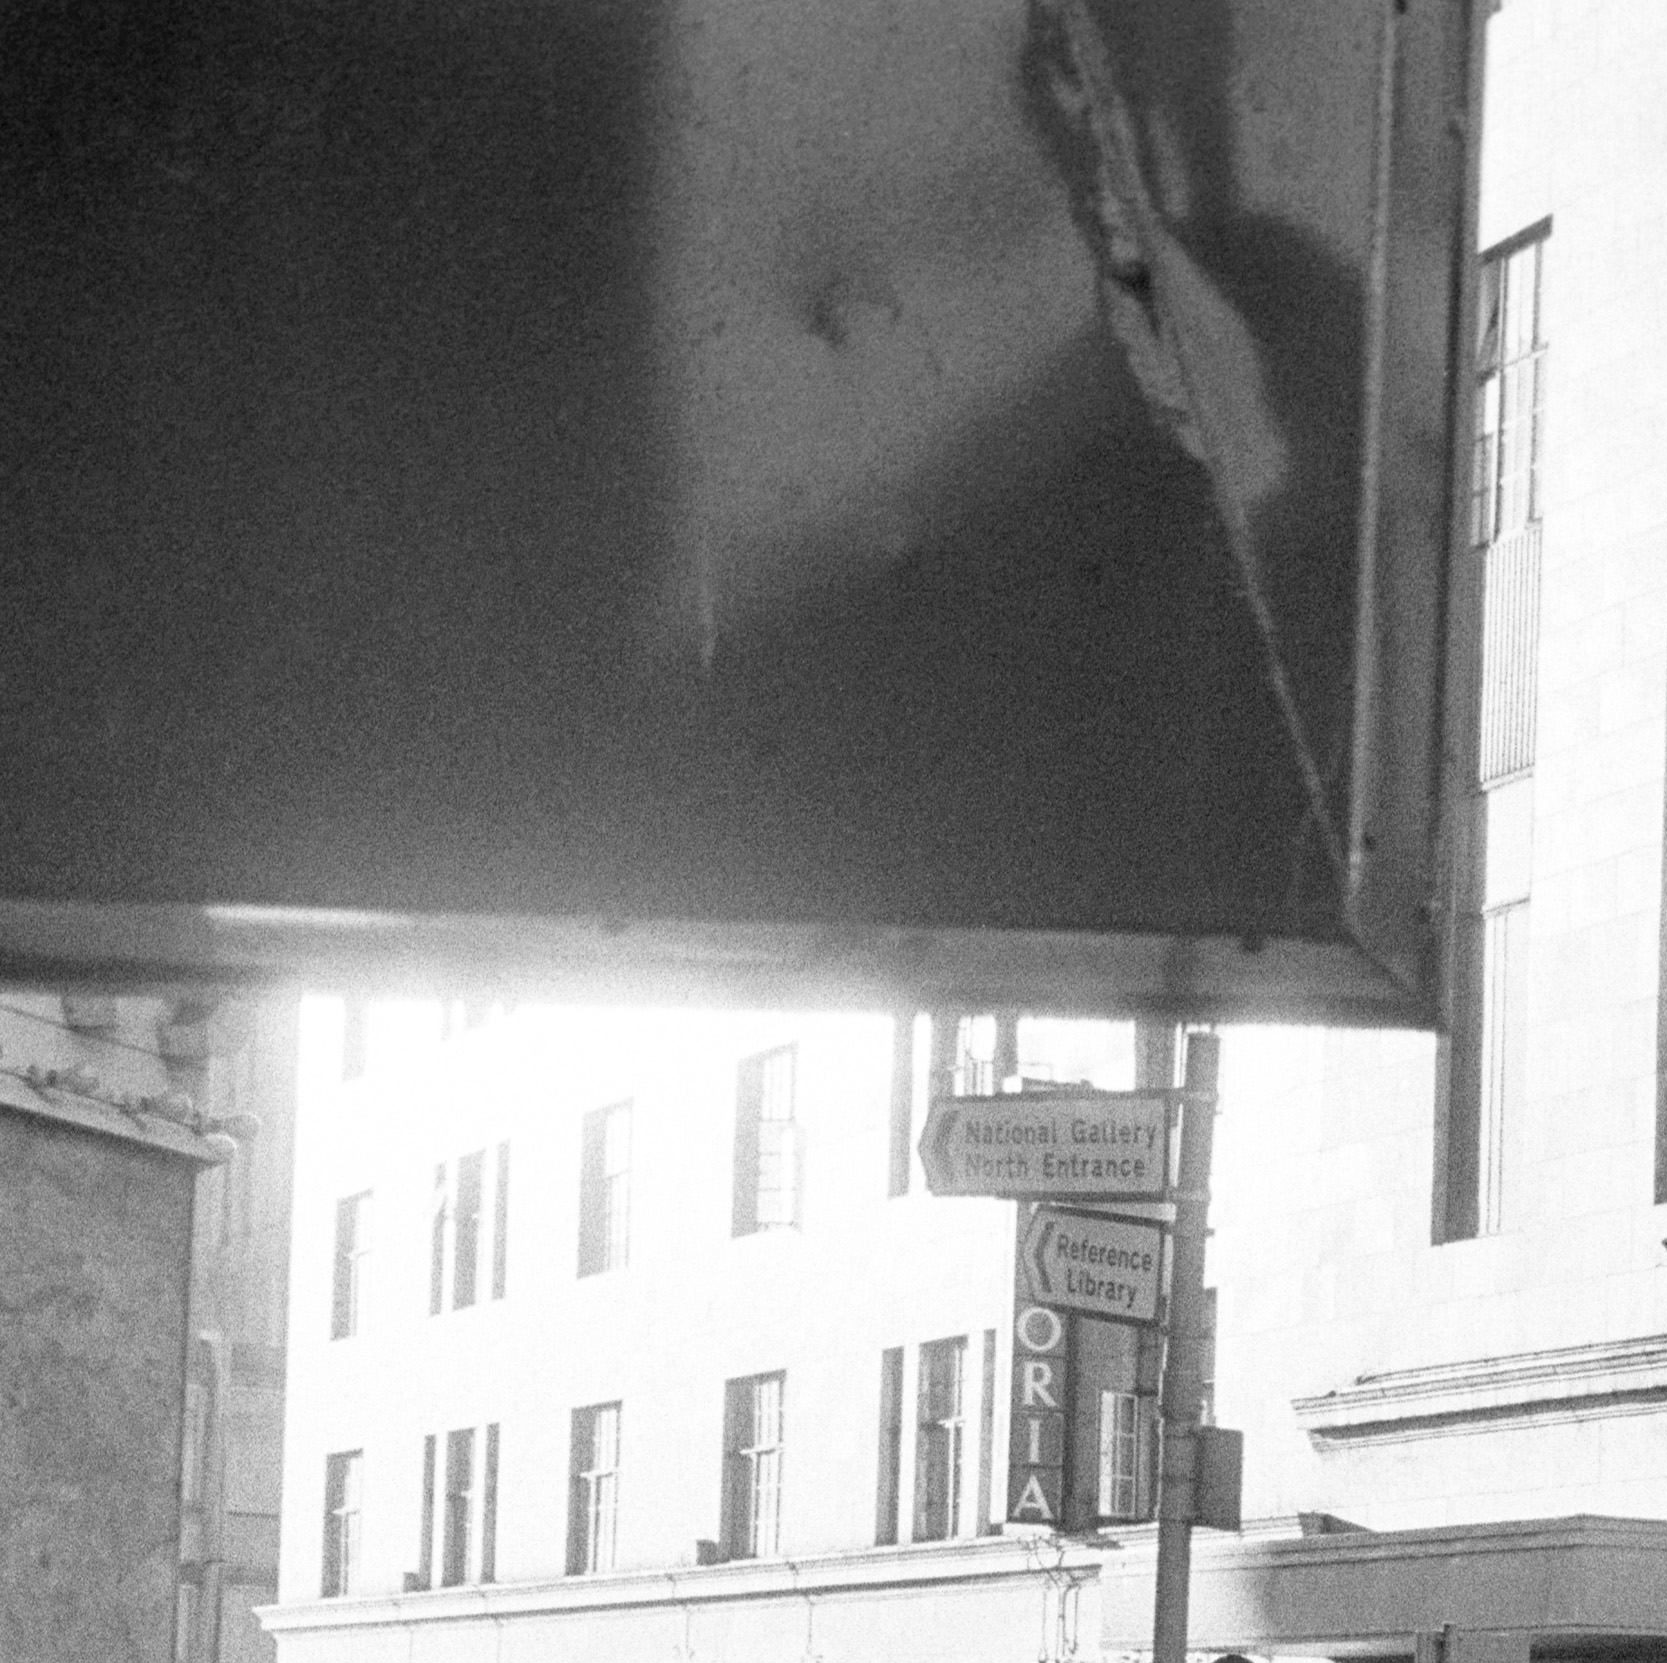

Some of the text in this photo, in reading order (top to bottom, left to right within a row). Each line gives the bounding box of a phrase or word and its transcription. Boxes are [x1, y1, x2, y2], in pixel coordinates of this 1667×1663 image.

[964, 1117, 1158, 1149] National Gallery
[964, 1151, 1147, 1179] North Entrance
[1056, 1233, 1154, 1273] Reference
[1066, 1268, 1139, 1310] Library
